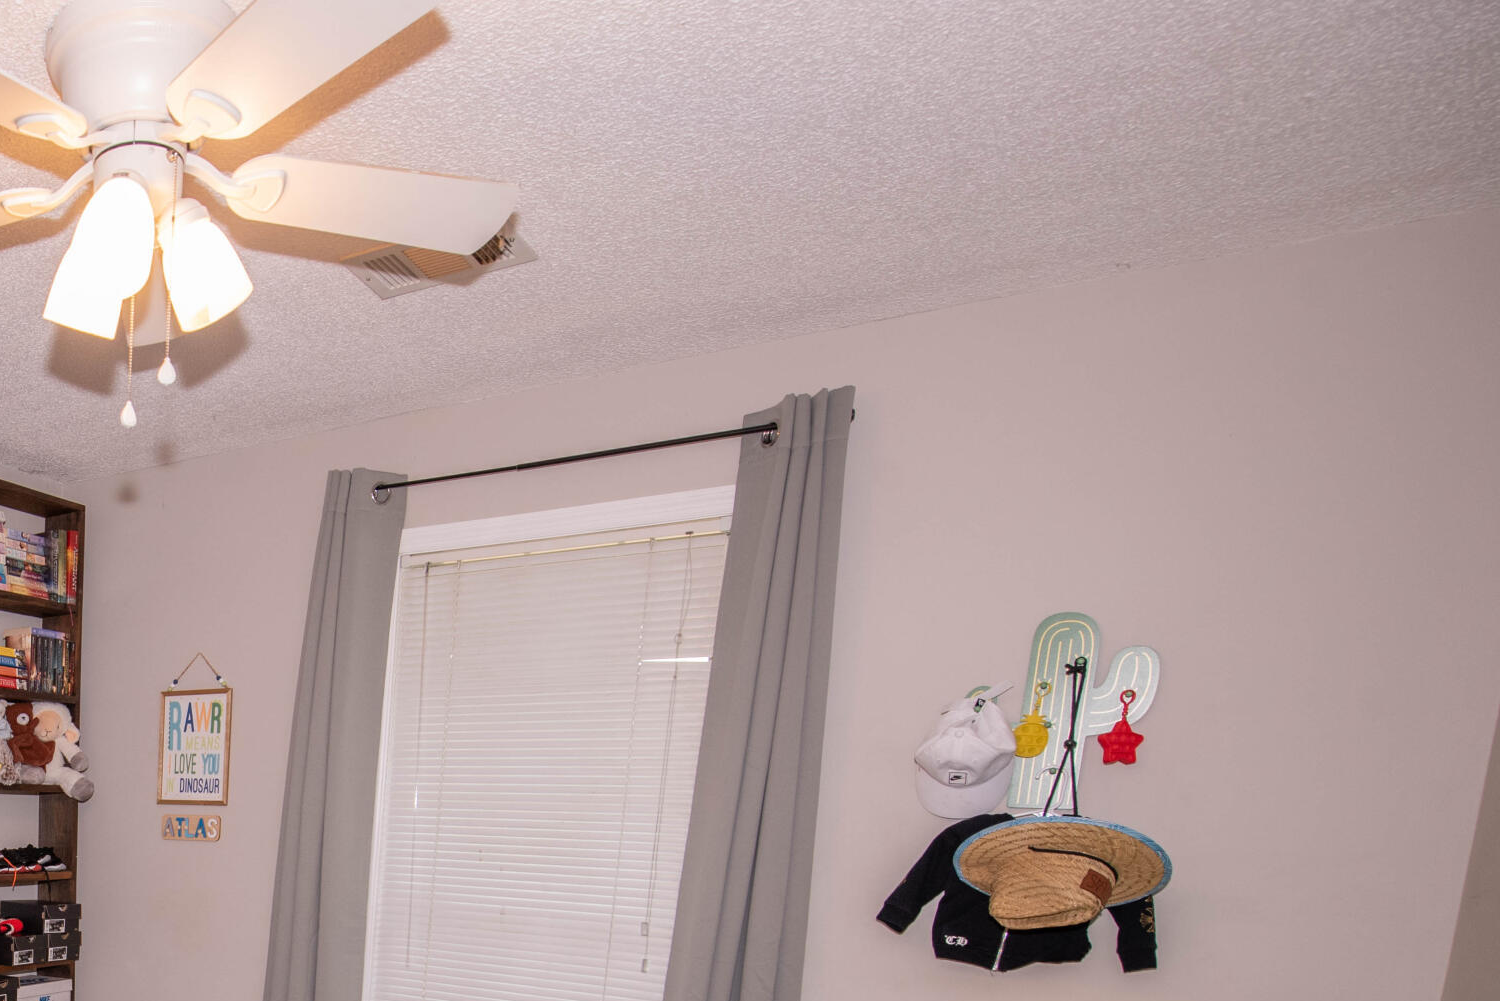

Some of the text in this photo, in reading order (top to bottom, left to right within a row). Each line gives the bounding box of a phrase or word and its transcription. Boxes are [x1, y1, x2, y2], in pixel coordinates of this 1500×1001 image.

[168, 701, 222, 750] RAWR
[186, 736, 221, 750] MEANS
[174, 753, 221, 775] LOVE YOU
[167, 778, 220, 794] IN DINOSAUR
[164, 817, 218, 838] ATLAS
